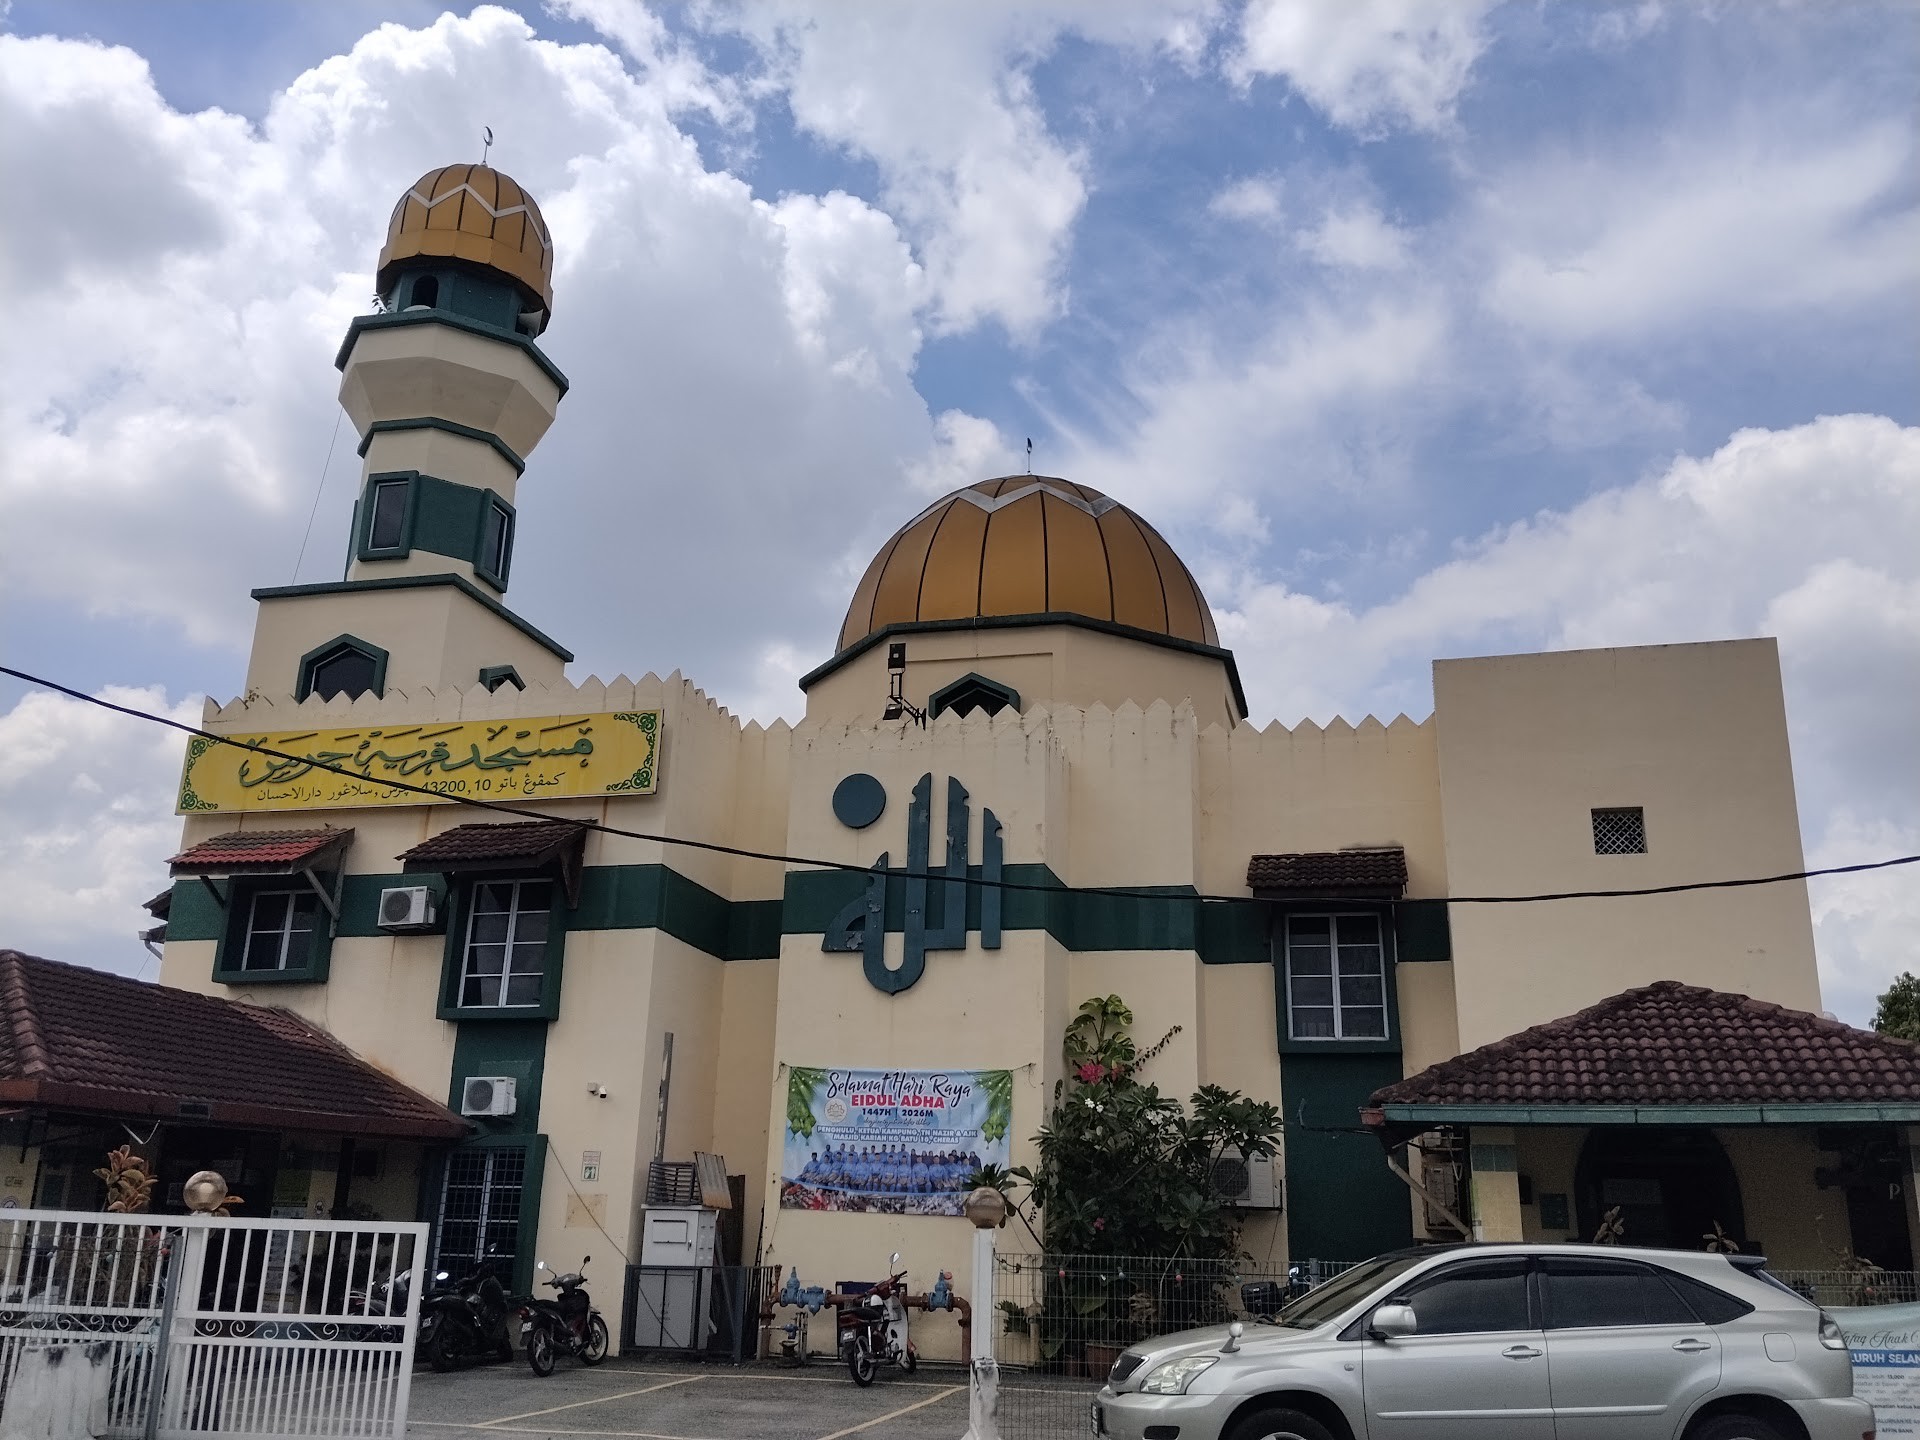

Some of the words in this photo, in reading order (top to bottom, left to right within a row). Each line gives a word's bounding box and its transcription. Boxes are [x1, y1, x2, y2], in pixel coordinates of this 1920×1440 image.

[495, 776, 517, 793] باتو
[826, 1071, 892, 1098] Selamat
[892, 1071, 926, 1099] Hari
[929, 1074, 971, 1107] Raya
[851, 1094, 895, 1107] EIDUL
[900, 1095, 945, 1108] ADHA
[862, 1108, 892, 1116] 1447H
[902, 1109, 934, 1117] 2026M
[933, 1129, 954, 1137] NAZIR
[1870, 1330, 1909, 1349] Anak
